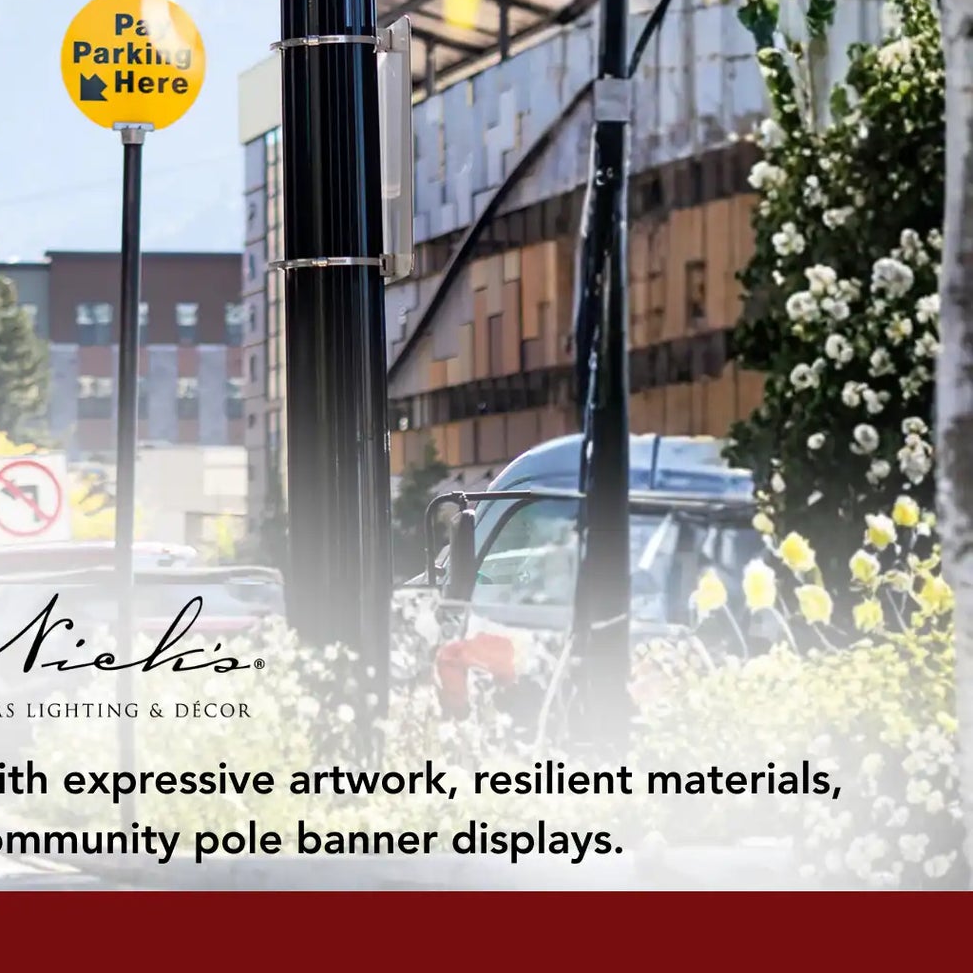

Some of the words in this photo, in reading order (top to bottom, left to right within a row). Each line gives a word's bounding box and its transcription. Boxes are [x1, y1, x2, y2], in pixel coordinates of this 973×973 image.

[115, 13, 172, 42] Pa
[73, 41, 191, 70] Parking
[115, 70, 188, 94] Here
